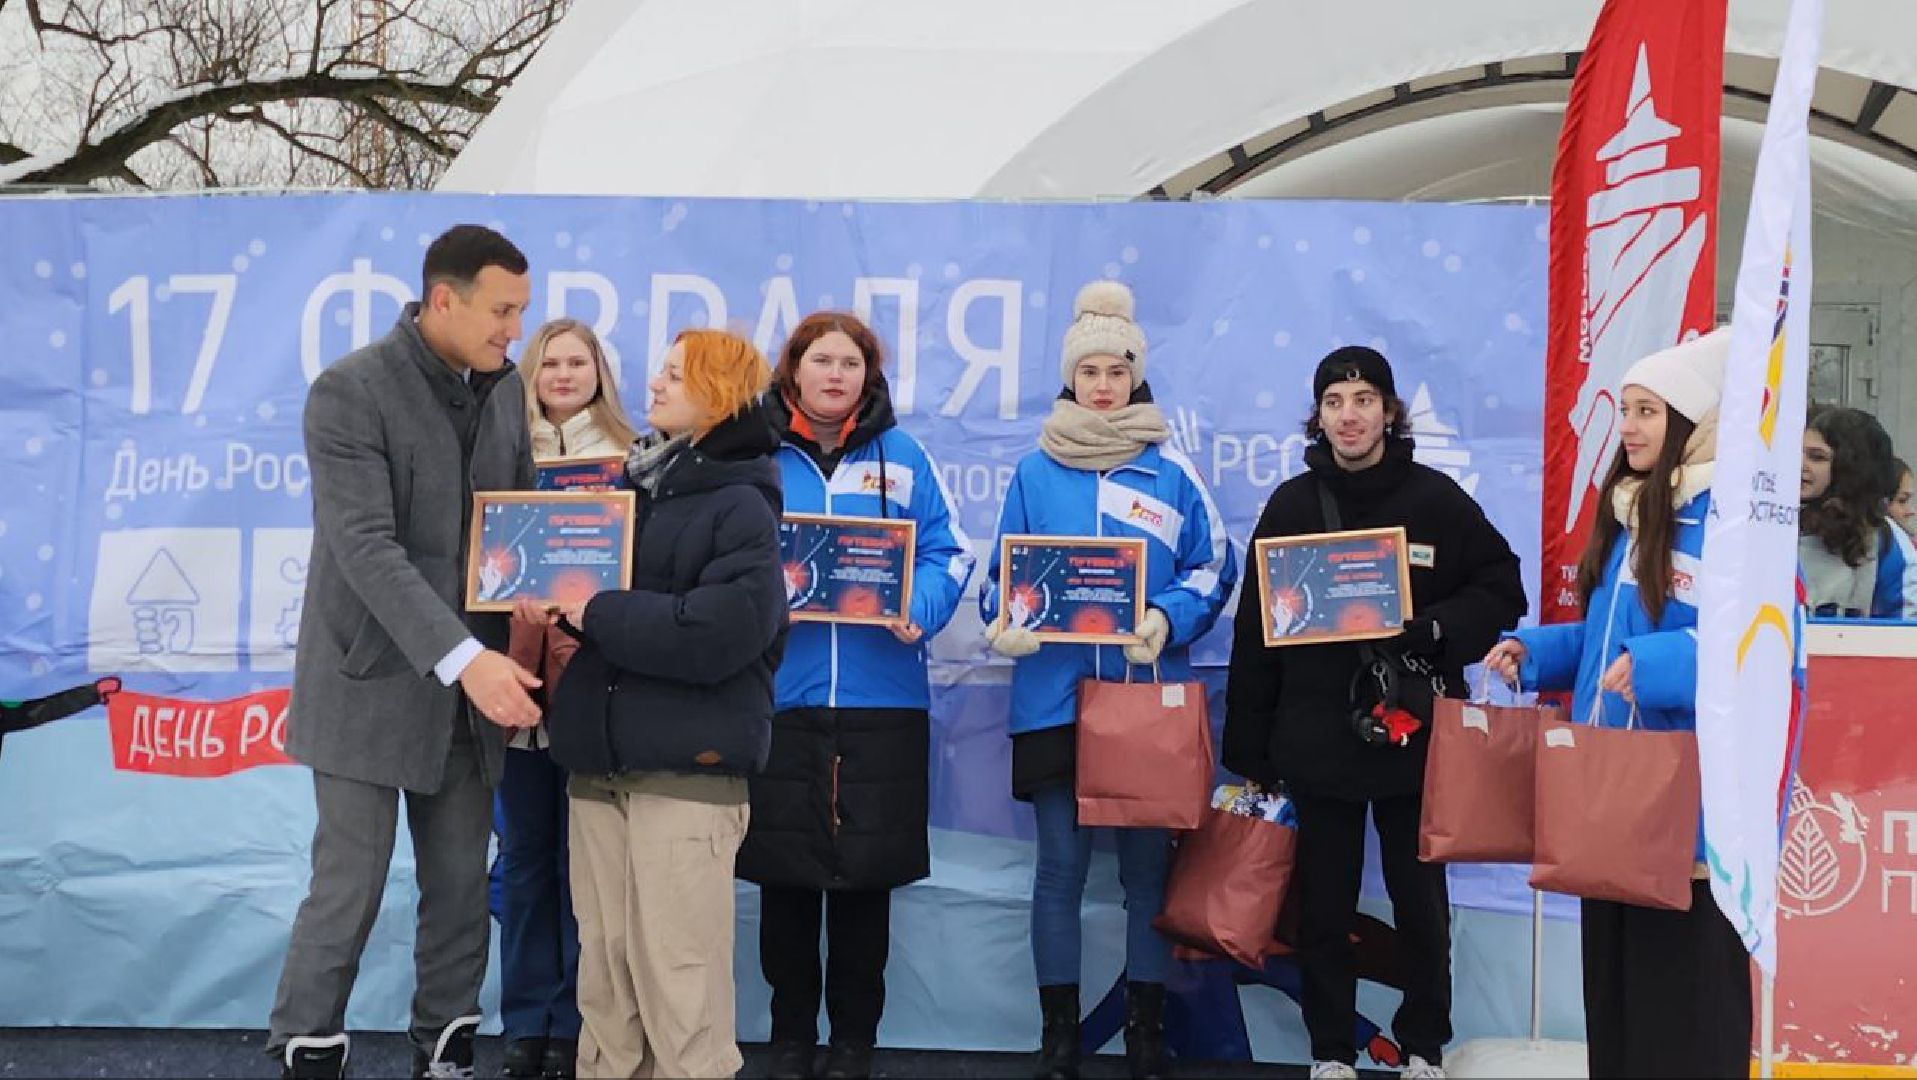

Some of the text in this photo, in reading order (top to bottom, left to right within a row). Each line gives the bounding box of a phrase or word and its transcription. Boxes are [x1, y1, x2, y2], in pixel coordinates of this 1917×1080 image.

[108, 257, 1023, 421] 17 ФВРАЛЯ
[105, 449, 210, 502] День
[128, 703, 227, 766] ДЕНЬ
